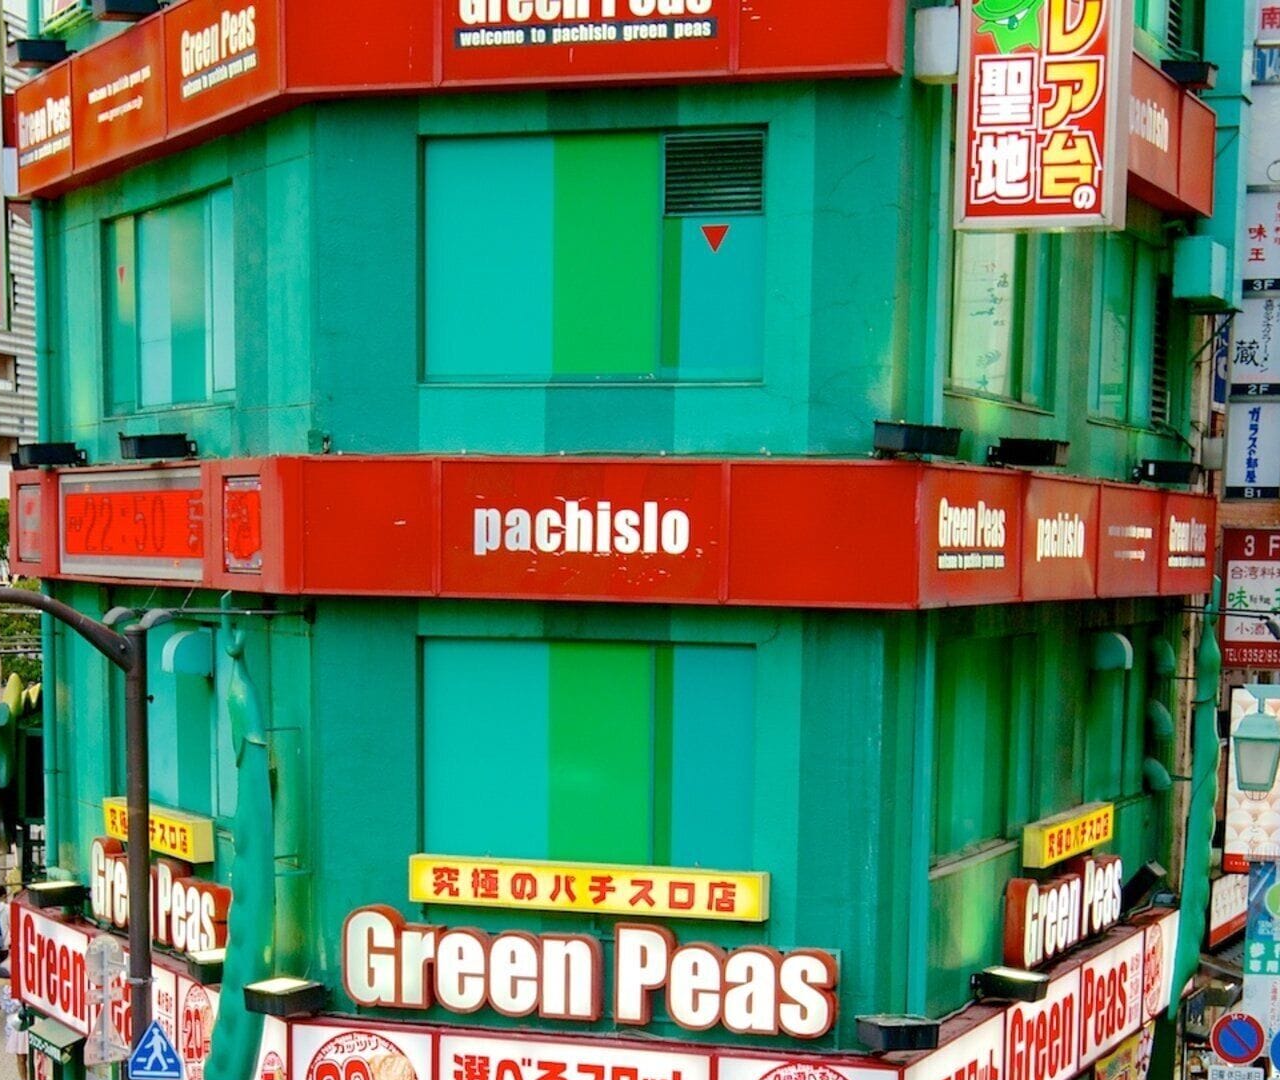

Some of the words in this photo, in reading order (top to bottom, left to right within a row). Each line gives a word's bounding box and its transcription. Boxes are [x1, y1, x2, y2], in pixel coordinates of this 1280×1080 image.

[181, 22, 219, 78] Green
[221, 5, 256, 59] Peas
[460, 28, 524, 48] welcome
[530, 26, 545, 43] to
[552, 23, 616, 46] pachislo
[623, 24, 667, 43] green
[674, 21, 712, 41] peas
[974, 56, 1039, 204] 聖地
[1041, 0, 1104, 210] レア台の
[1248, 223, 1268, 262] 味王
[1252, 279, 1276, 291] 3F
[1233, 338, 1260, 368] 蔵
[1247, 384, 1270, 396] 2F
[1245, 406, 1261, 484] ガラスの部屋
[1243, 487, 1262, 498] B1
[473, 500, 692, 557] pachislo
[938, 497, 976, 548] Green
[977, 500, 1006, 547] Peas
[1036, 512, 1085, 562] pachislo
[1228, 586, 1249, 609] 味
[109, 808, 189, 854] 究極チスロ店
[90, 838, 155, 929] Gre
[156, 860, 216, 951] Peas
[431, 865, 738, 913] 究極のパチスロ店
[1023, 876, 1082, 969] Green
[1081, 857, 1123, 938] Peas
[23, 914, 87, 1021] Green
[344, 907, 600, 1022] Green
[617, 923, 837, 1038] Peas
[1081, 959, 1128, 1057] Peas
